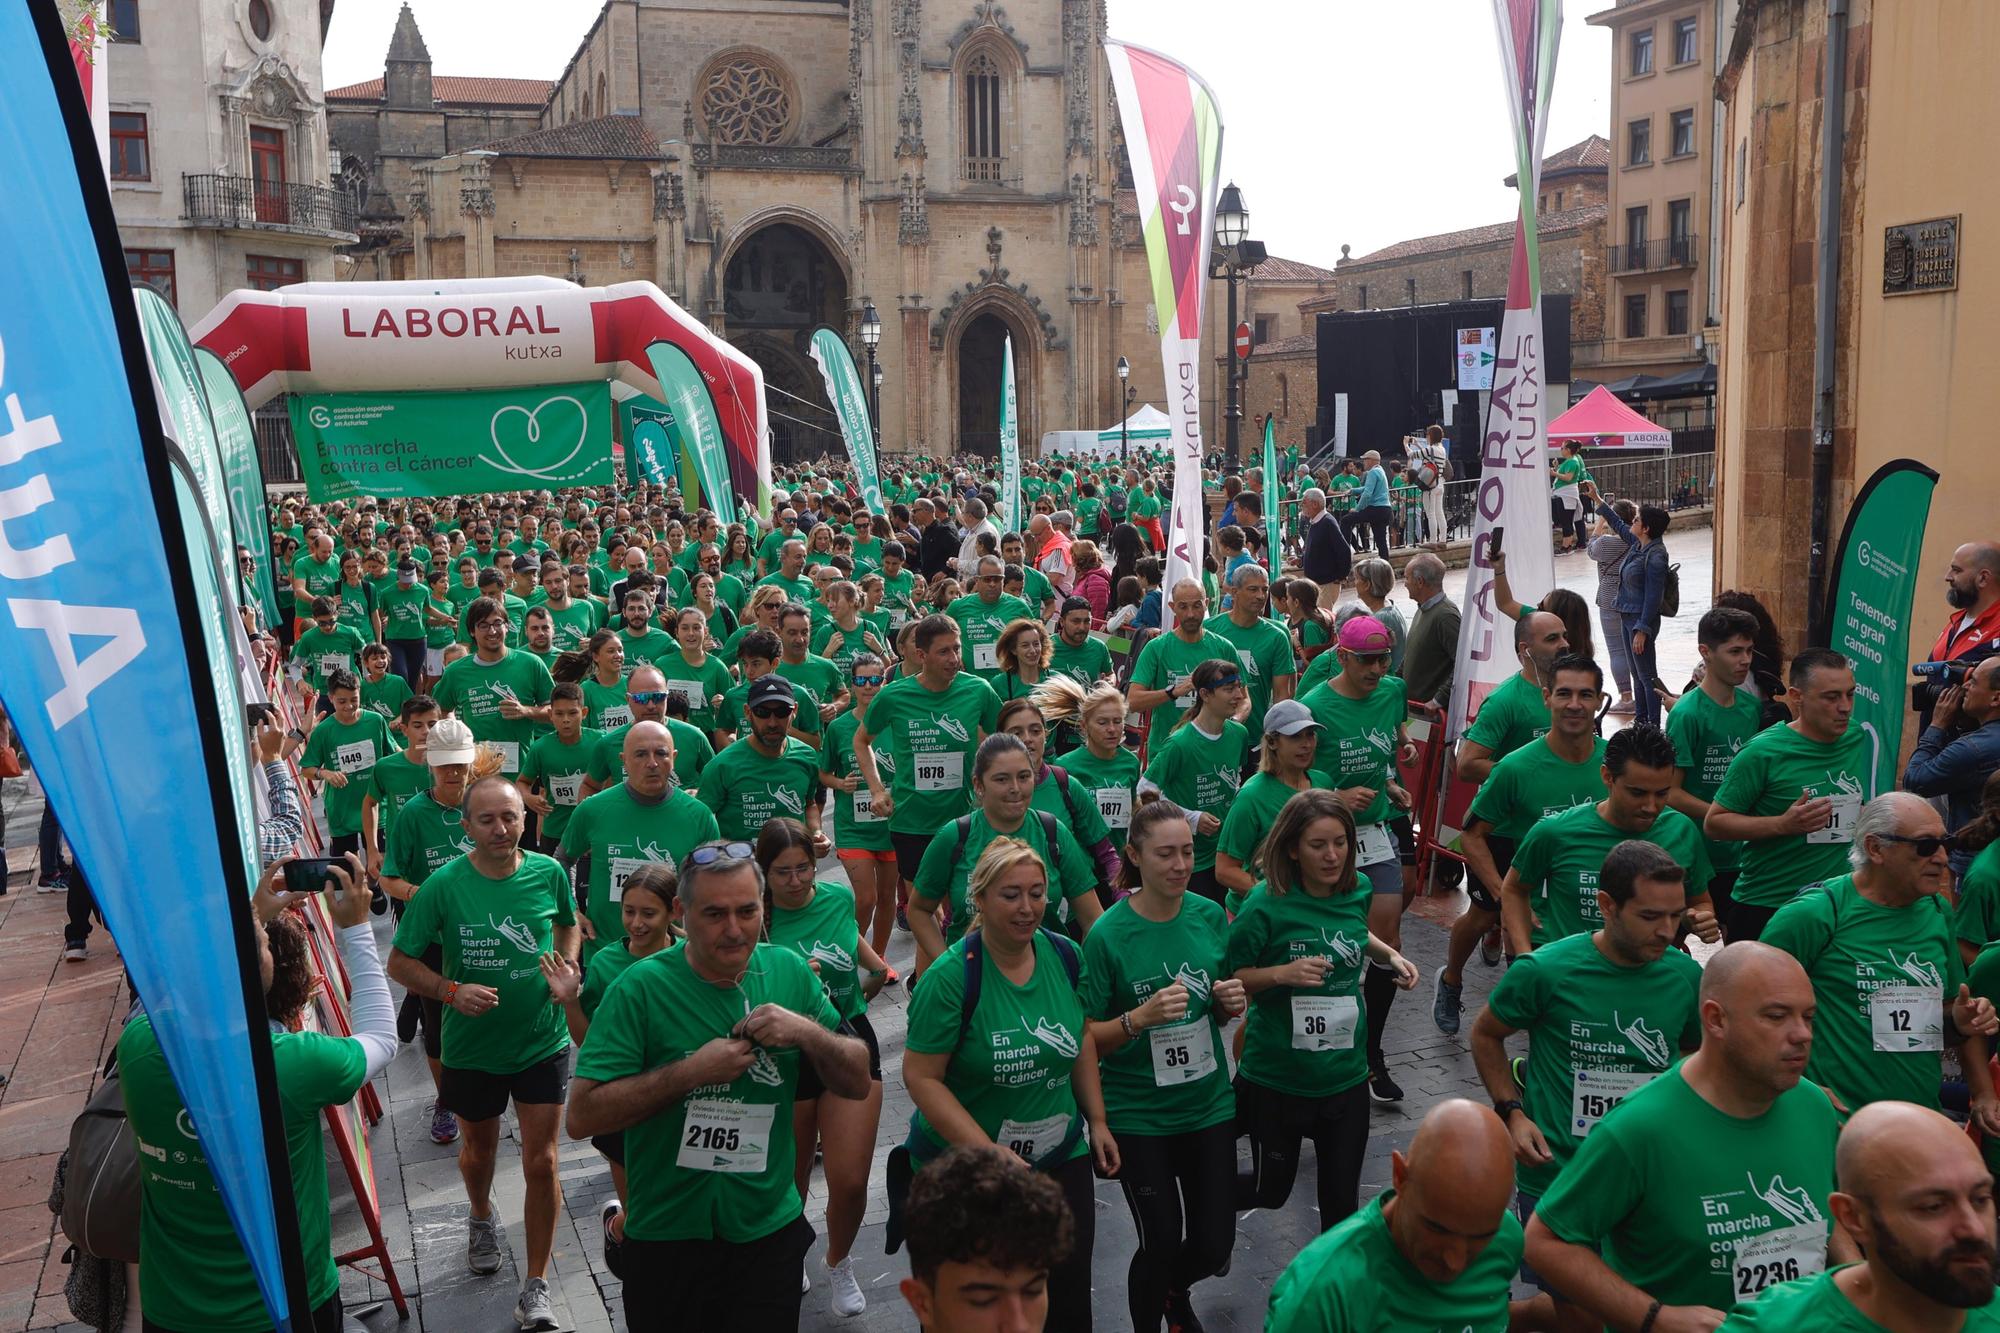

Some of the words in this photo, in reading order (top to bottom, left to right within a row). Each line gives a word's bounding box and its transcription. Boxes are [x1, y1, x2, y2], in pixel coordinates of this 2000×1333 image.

[1919, 227, 1947, 240] CALLE
[1915, 246, 1949, 260] EUSEBIO
[1914, 272, 1947, 285] ABASCAL
[342, 305, 560, 338] LABORAL
[505, 342, 562, 360] kutxa
[1512, 334, 1538, 469] kutxa
[1628, 434, 1670, 442] LABORAL
[317, 442, 338, 458] En
[344, 439, 419, 457] marcha
[320, 459, 380, 476] contra
[385, 460, 404, 473] el
[409, 455, 476, 473] cáncer
[1471, 335, 1521, 661] LABORAL
[1850, 591, 1897, 631] Tenemos
[1846, 614, 1859, 630] un
[1861, 623, 1886, 646] gran
[1844, 634, 1882, 664] camino
[1846, 655, 1859, 672] or
[1917, 664, 1934, 674] tve
[469, 693, 494, 702] marcha
[607, 716, 628, 728] 2260
[908, 721, 920, 729] En
[909, 728, 940, 736] marcha
[910, 736, 936, 744] contra
[1340, 740, 1353, 749] En
[920, 743, 948, 751] cáncer
[1341, 746, 1372, 758] marcha
[1706, 747, 1718, 755] En
[340, 752, 362, 766] 1449
[1341, 755, 1368, 765] contra
[917, 766, 945, 779] 1878
[1351, 761, 1378, 772] cáncer
[1196, 776, 1208, 784] En
[1197, 781, 1221, 791] marcha
[556, 786, 575, 798] 851
[742, 794, 755, 802] En
[1197, 788, 1218, 798] contra
[1205, 794, 1226, 804] cáncer
[743, 802, 776, 811] marcha
[1100, 803, 1122, 816] 1877
[743, 810, 772, 818] contra
[425, 850, 438, 858] En
[608, 847, 621, 855] En
[1579, 874, 1596, 884] En
[1581, 907, 1591, 917] el
[460, 927, 473, 937] En
[461, 937, 500, 947] marcha
[1289, 942, 1306, 951] En
[462, 948, 495, 957] contra
[462, 957, 471, 966] el
[472, 957, 510, 967] cáncer
[1856, 964, 1875, 976] En
[1133, 982, 1151, 995] En
[1857, 977, 1908, 990] marcha
[1859, 1004, 1871, 1015] el
[1304, 1016, 1326, 1035] 36
[1889, 1009, 1911, 1031] 12
[1571, 1023, 1590, 1038] En
[992, 1034, 1010, 1047] En
[1570, 1039, 1625, 1054] marcha
[993, 1044, 1040, 1060] marcha
[1165, 1046, 1189, 1067] 35
[1570, 1050, 1616, 1063] contra
[993, 1059, 1034, 1073] contra
[1571, 1061, 1583, 1071] el
[1587, 1062, 1635, 1073] cáncer
[993, 1074, 1006, 1083] el
[1009, 1067, 1049, 1084] cáncer
[693, 1104, 715, 1113] Oviedo
[720, 1114, 742, 1122] cáncer
[686, 1125, 739, 1151] 2165
[1702, 1199, 1729, 1217] En
[1707, 1213, 1772, 1235] marcha
[1710, 1254, 1727, 1269] el
[1737, 1257, 1799, 1294] 2236
